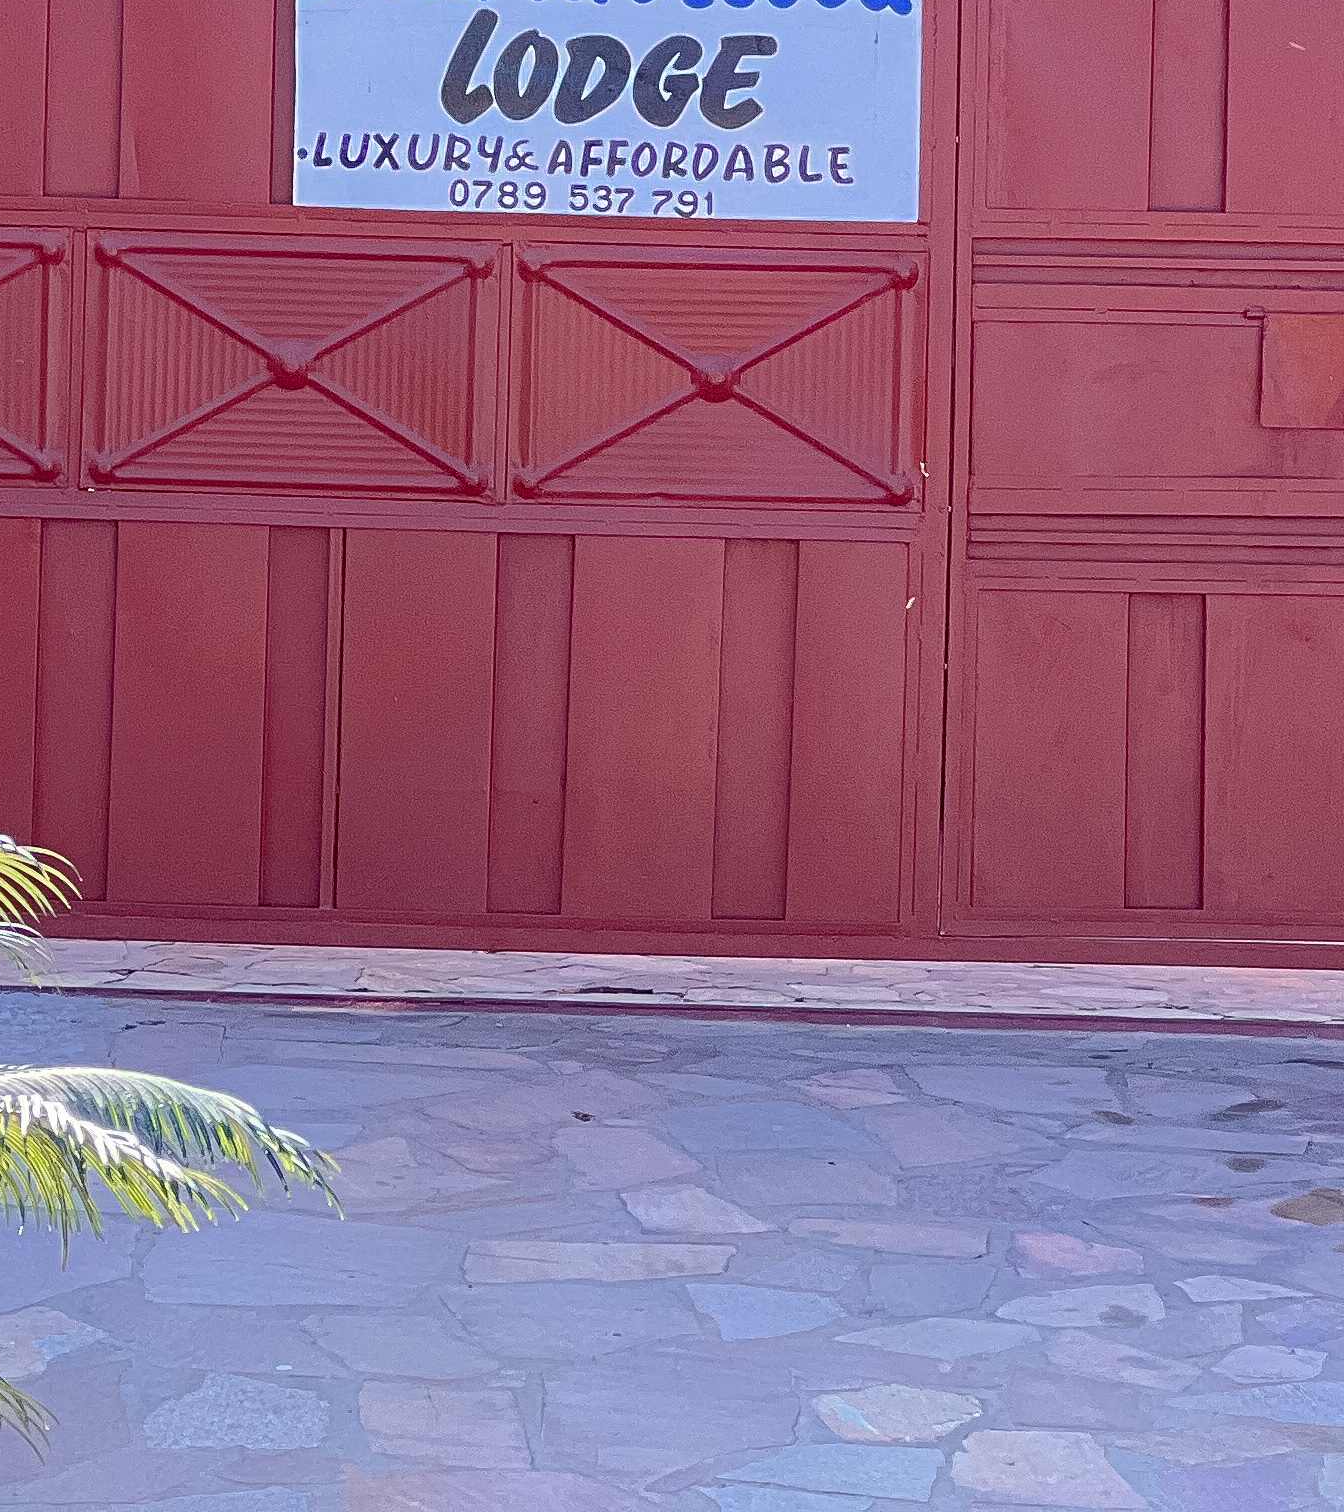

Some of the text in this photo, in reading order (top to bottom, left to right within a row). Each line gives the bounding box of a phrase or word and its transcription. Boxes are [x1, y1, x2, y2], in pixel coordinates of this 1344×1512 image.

[440, 8, 778, 130] LODGE
[449, 179, 714, 218] 0789 537 791
